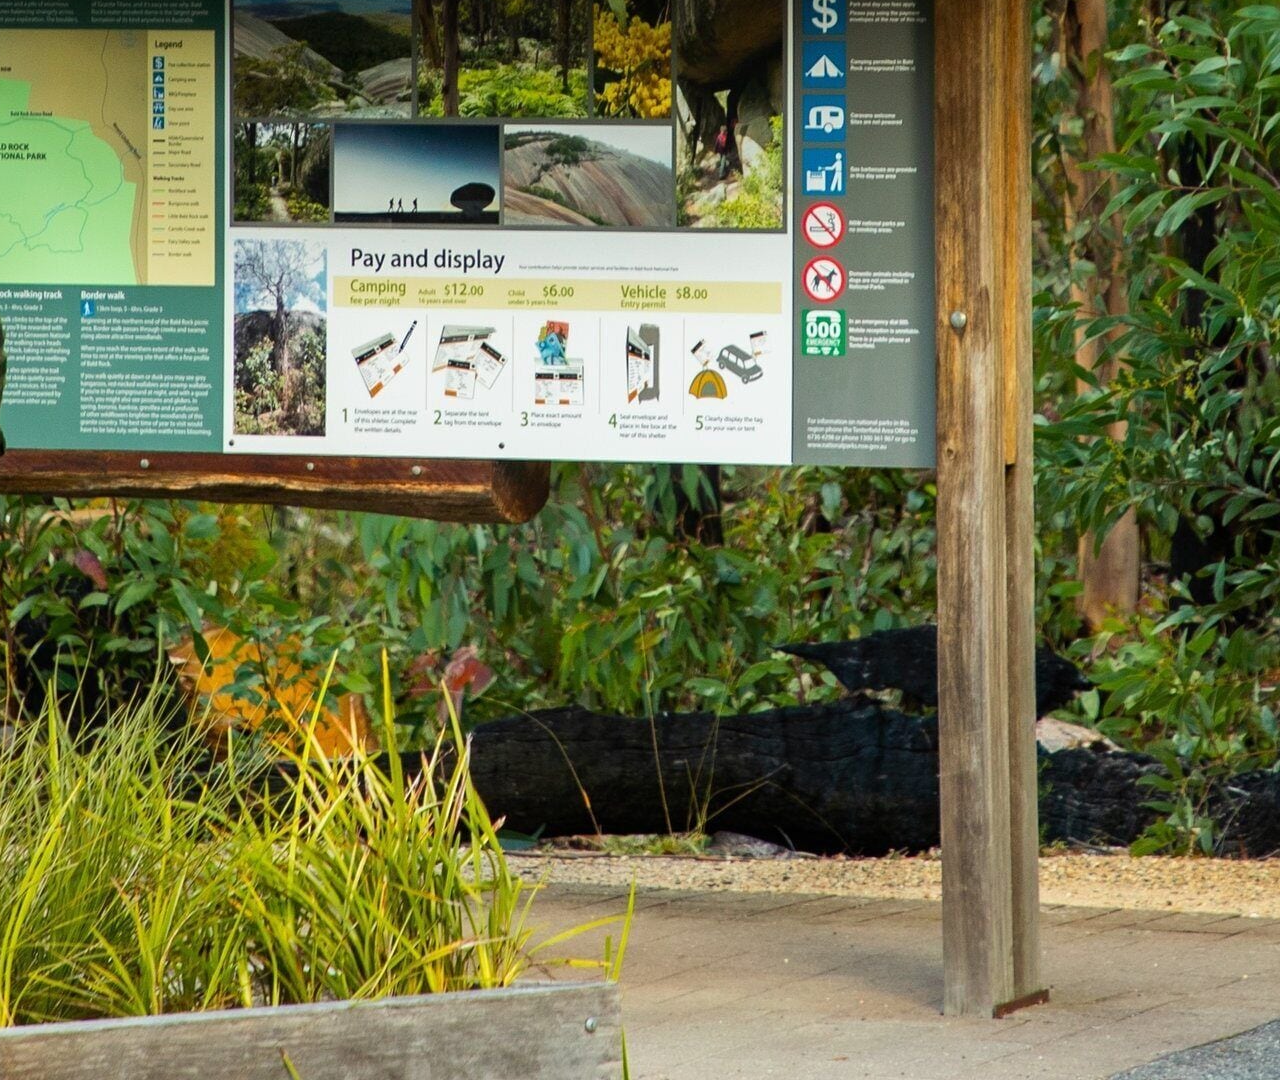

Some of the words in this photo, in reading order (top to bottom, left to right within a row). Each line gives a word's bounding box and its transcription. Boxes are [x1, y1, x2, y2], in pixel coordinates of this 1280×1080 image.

[155, 40, 182, 49] Legend
[351, 248, 385, 272] Pay
[390, 249, 428, 268] and
[434, 249, 505, 274] display
[351, 279, 406, 296] Camping
[444, 283, 483, 296] $12.00
[543, 285, 574, 297] $6.00
[621, 285, 666, 299] Vehicle
[676, 286, 708, 300] $8.00
[13, 290, 42, 301] walking
[44, 290, 62, 299] track
[81, 290, 106, 299] Border
[108, 291, 125, 300] walk
[350, 296, 362, 305] fee
[364, 298, 377, 306] per
[379, 296, 400, 307] night
[621, 300, 640, 309] Entry
[642, 300, 666, 309] permit
[806, 322, 841, 338] 000
[342, 408, 347, 422] 1
[434, 410, 442, 424] 2
[521, 411, 528, 426] 3
[608, 413, 617, 428] 4
[696, 415, 703, 430] 5
